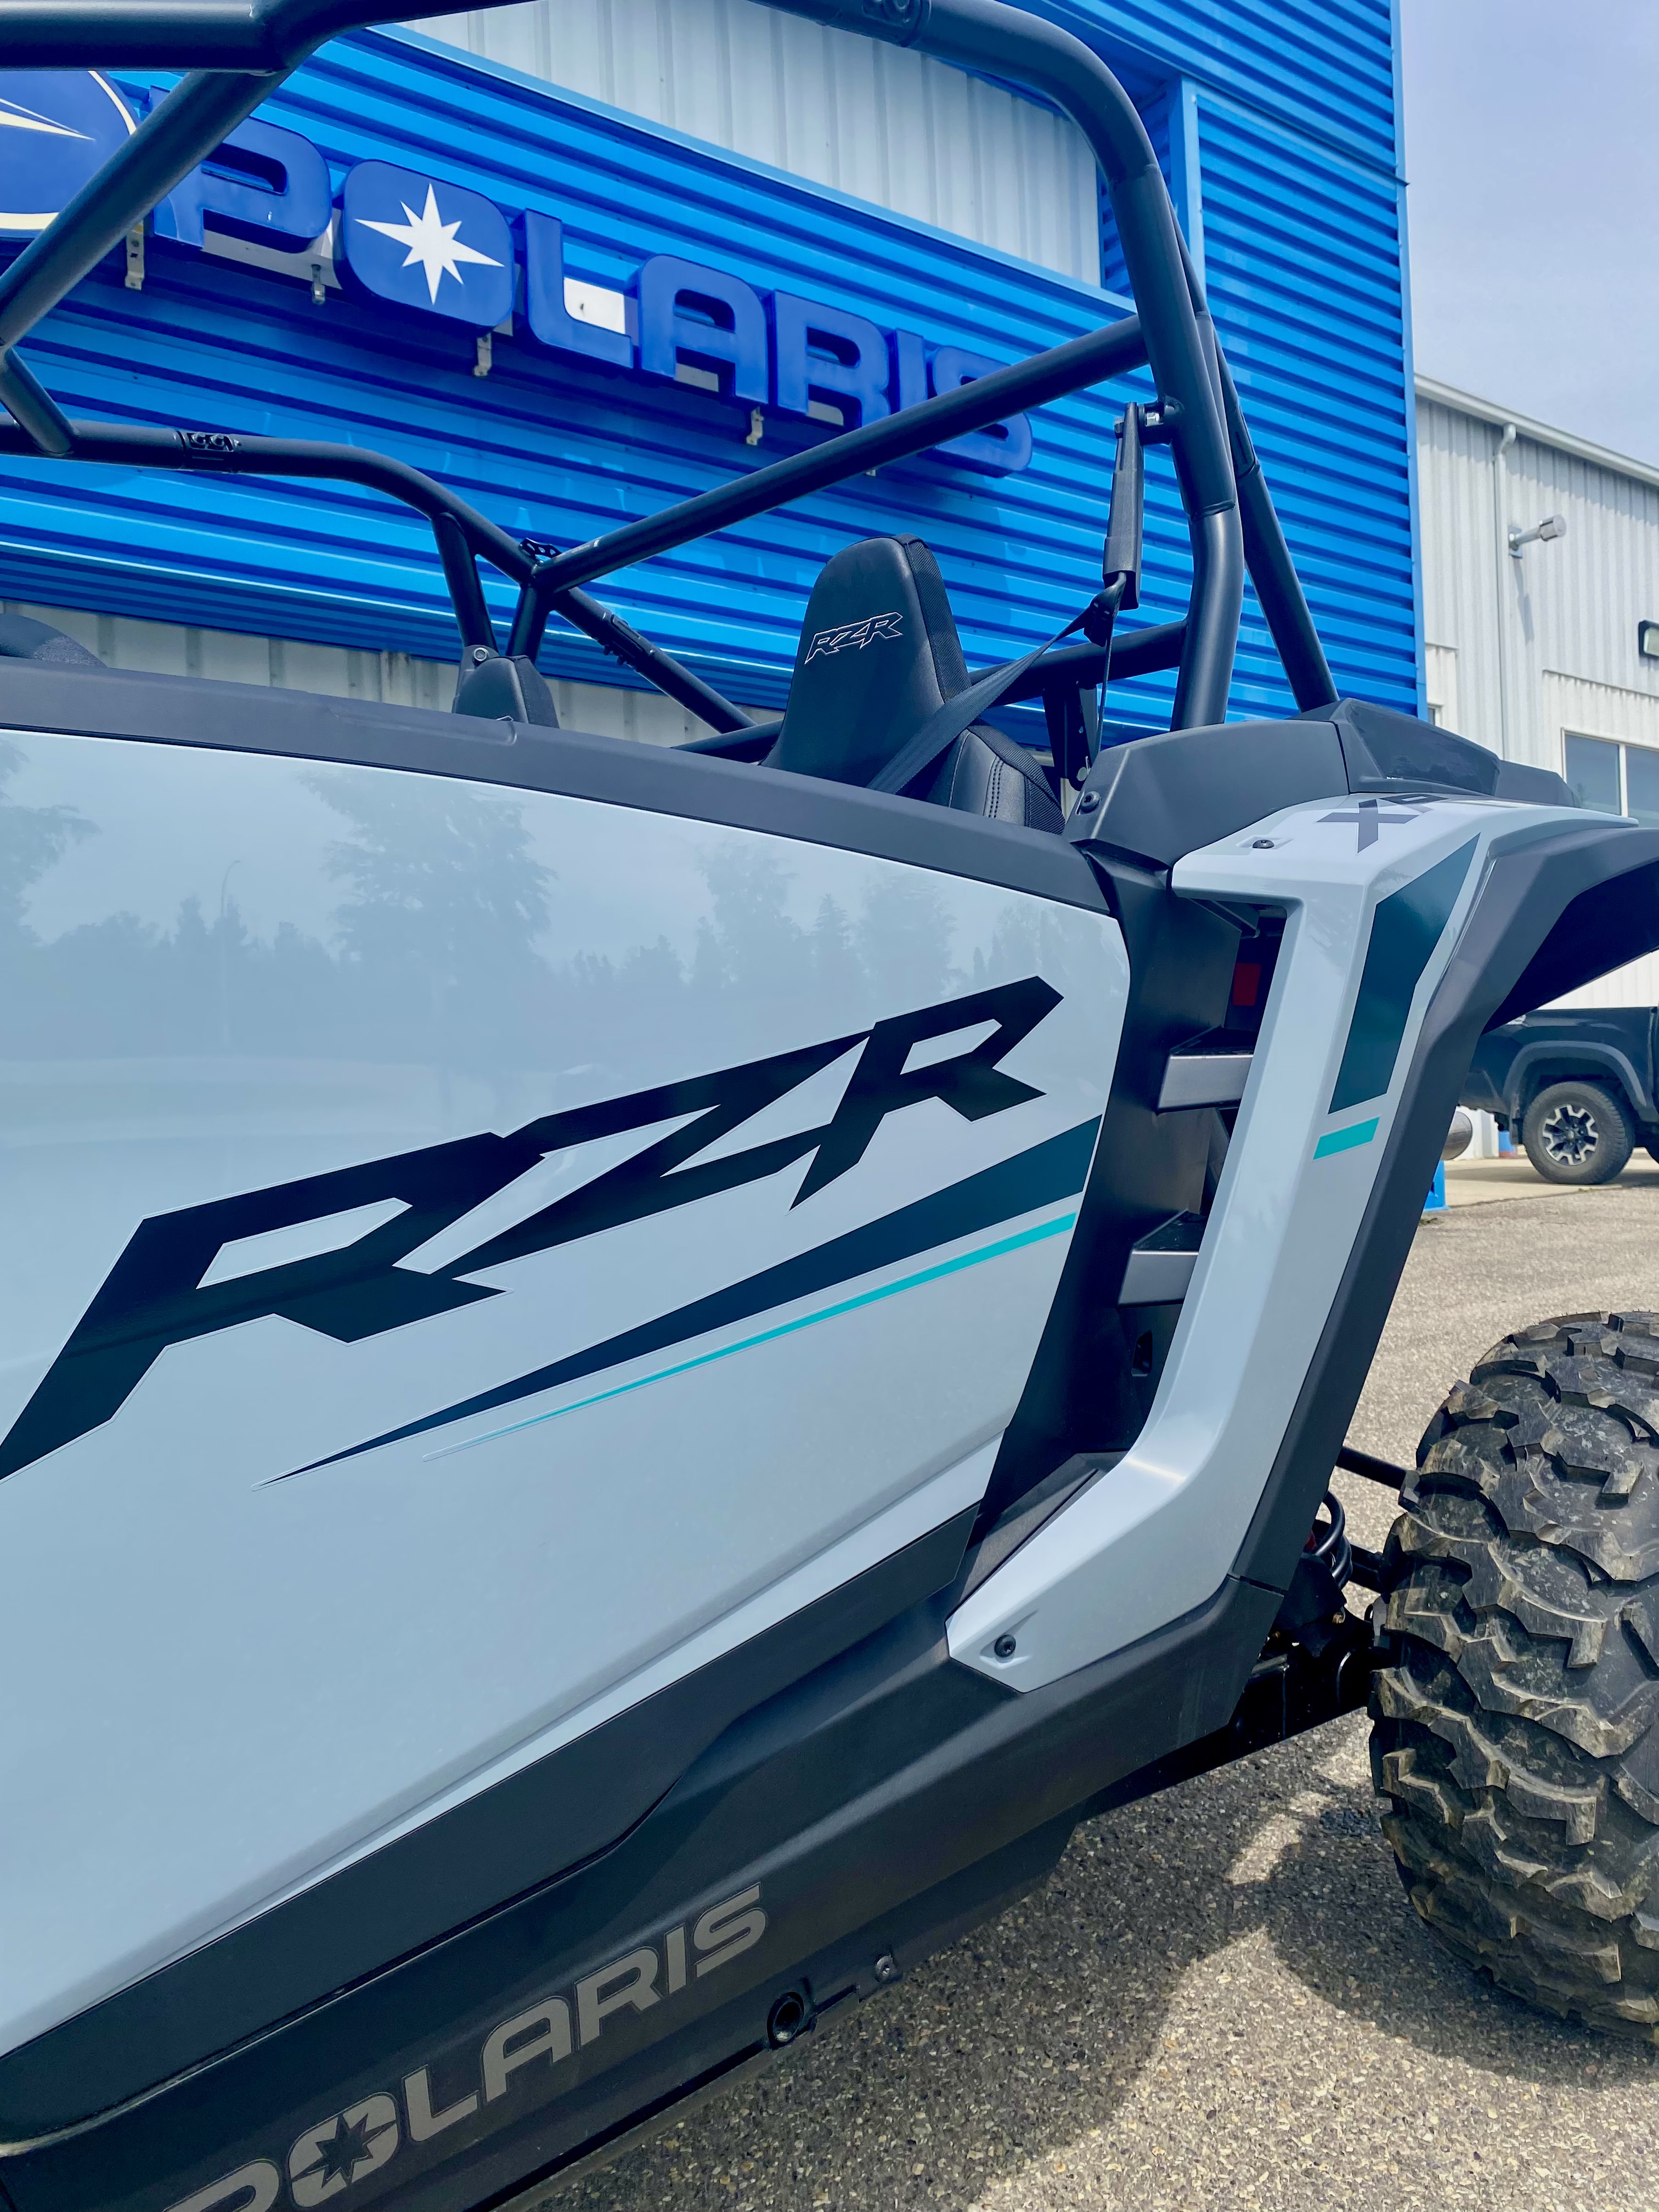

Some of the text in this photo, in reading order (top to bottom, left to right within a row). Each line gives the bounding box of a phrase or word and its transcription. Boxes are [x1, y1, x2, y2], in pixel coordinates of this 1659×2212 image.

[148, 86, 1032, 472] POLARIS
[804, 611, 904, 665] RZR
[1316, 793, 1450, 854] XP
[0, 975, 1064, 1482] RZR
